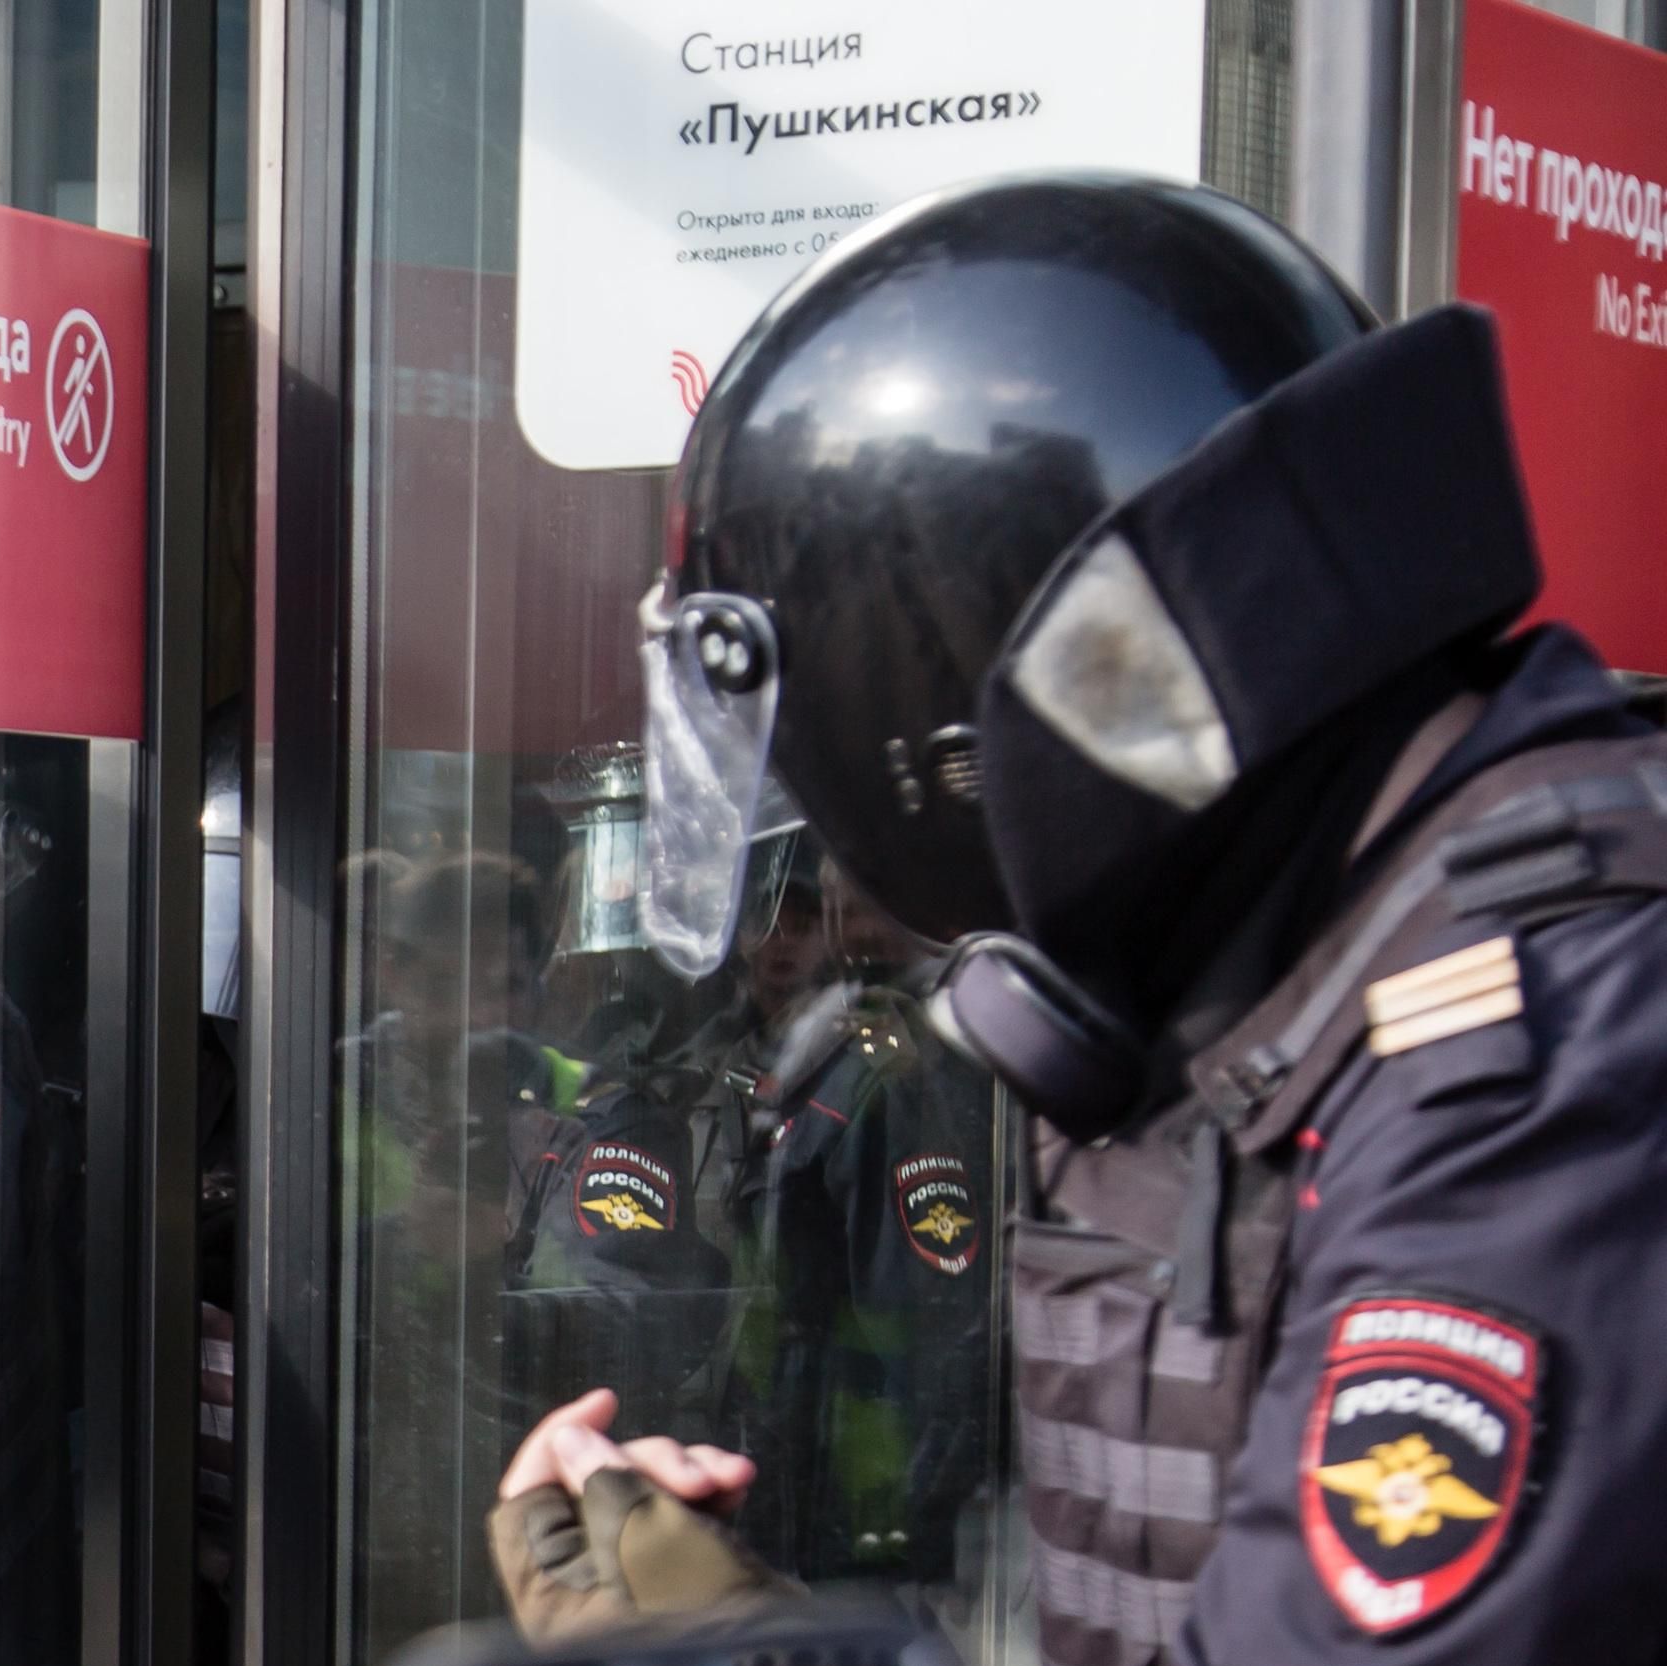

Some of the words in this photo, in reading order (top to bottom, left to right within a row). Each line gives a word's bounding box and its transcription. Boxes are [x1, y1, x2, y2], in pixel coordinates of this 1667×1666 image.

[680, 31, 863, 75] Станция
[678, 89, 1042, 156] «Пушкинская»
[1460, 98, 1535, 208] Нет
[1536, 147, 1667, 262] проход
[676, 208, 767, 234] Открыта
[771, 207, 806, 226] для
[675, 241, 788, 264] ежедневно
[794, 239, 806, 255] с
[1595, 271, 1632, 338] No
[587, 1171, 665, 1210] РОССИЯ
[592, 1146, 670, 1185] ПОЛИЦИЯ
[1342, 1308, 1527, 1379] ПОЛИЦИЯ
[1331, 1375, 1507, 1458] РОССИЯ
